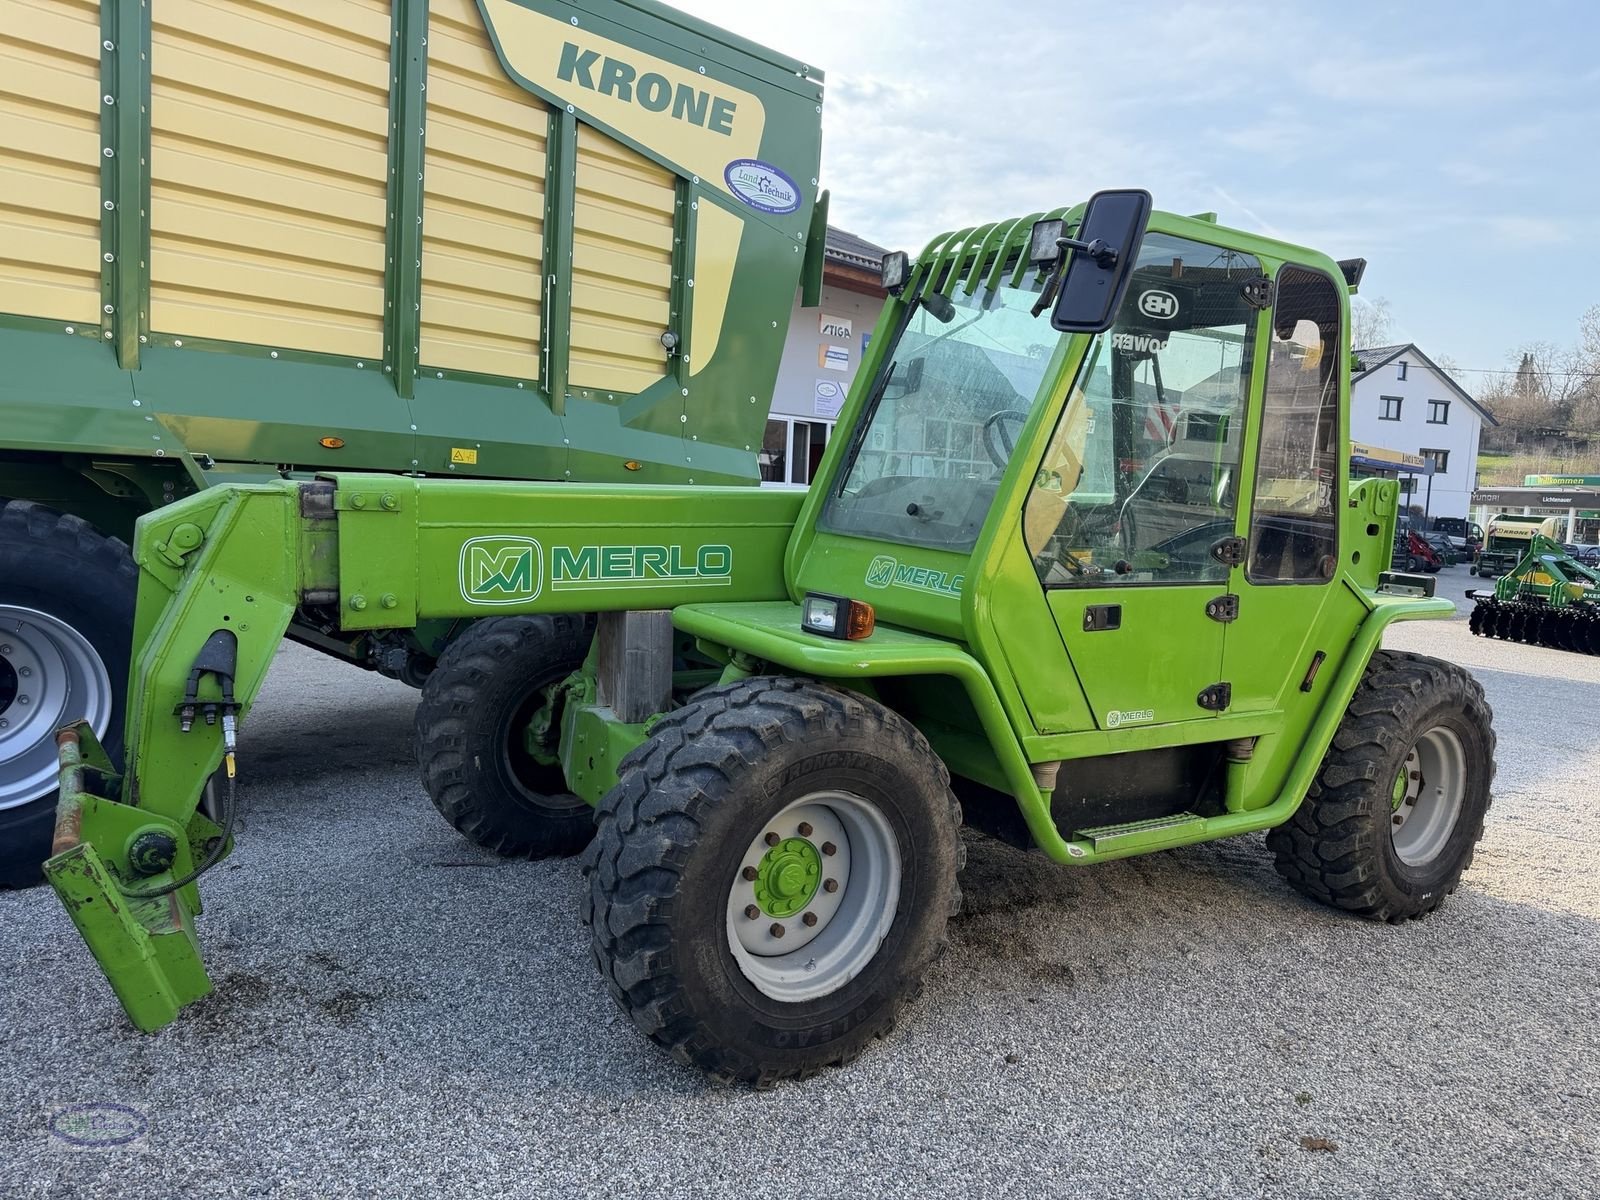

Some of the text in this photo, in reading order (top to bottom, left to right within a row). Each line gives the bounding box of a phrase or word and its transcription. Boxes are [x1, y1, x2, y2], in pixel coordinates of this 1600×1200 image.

[557, 41, 737, 137] KRONE
[738, 169, 758, 184] Land
[763, 184, 792, 202] Technik
[823, 324, 852, 338] STIGA
[552, 544, 733, 580] MERLO
[1121, 709, 1154, 721] MERLO
